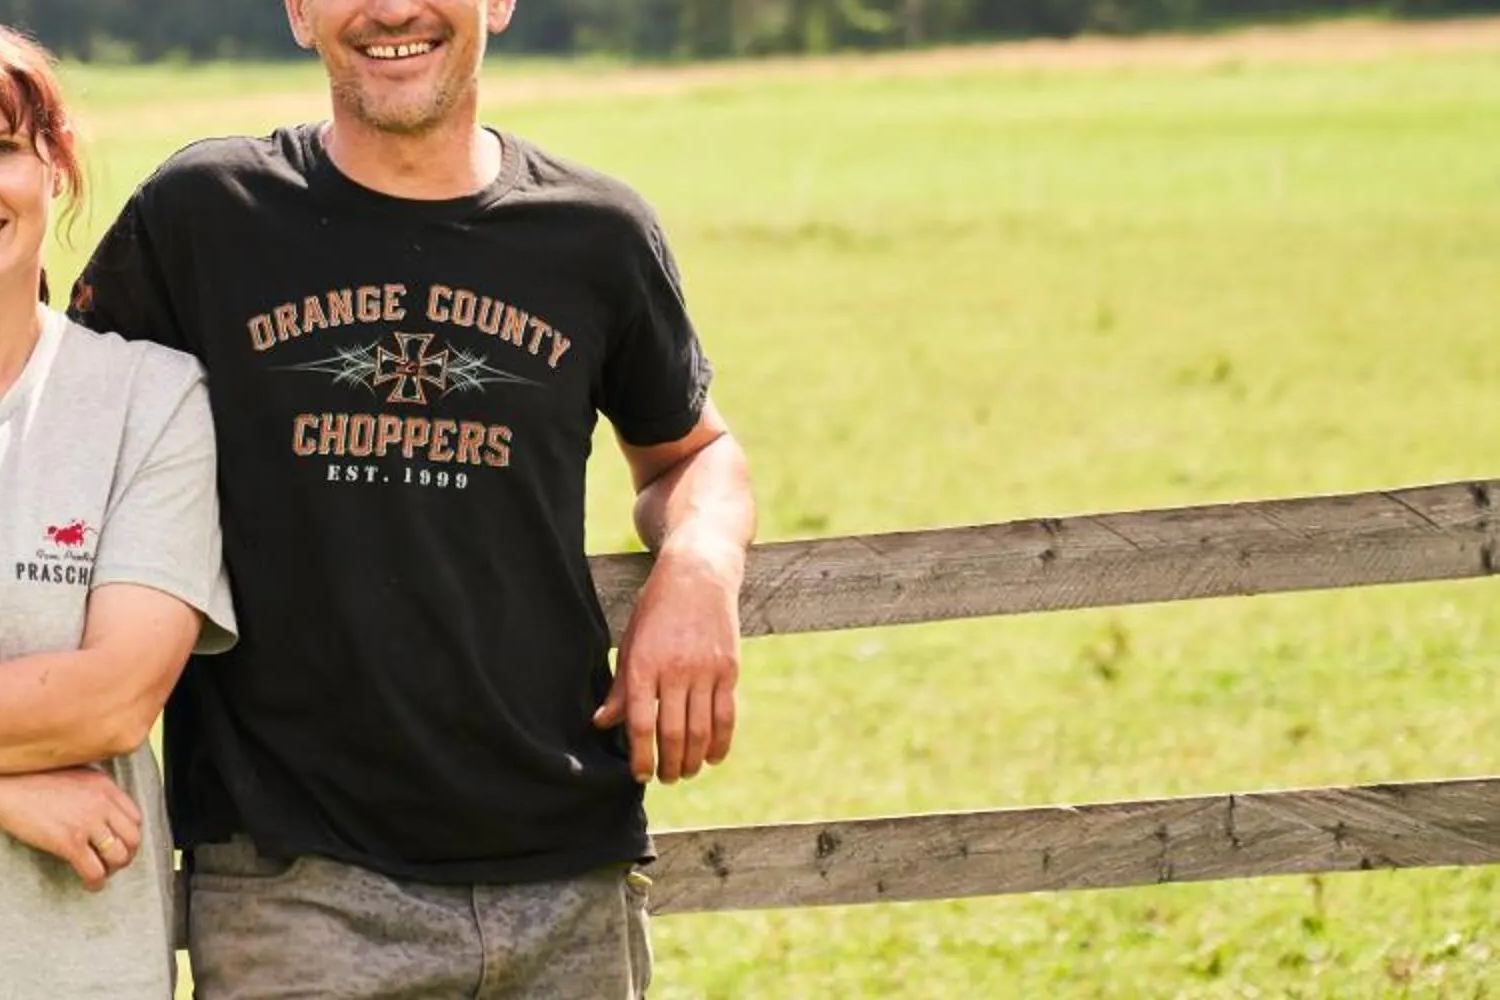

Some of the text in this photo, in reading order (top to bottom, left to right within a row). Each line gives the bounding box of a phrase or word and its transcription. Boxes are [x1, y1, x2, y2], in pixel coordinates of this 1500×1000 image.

[247, 284, 571, 368] ORANGE COUNTY
[292, 412, 513, 467] CHOPPERS
[327, 464, 469, 489] EST. 1999
